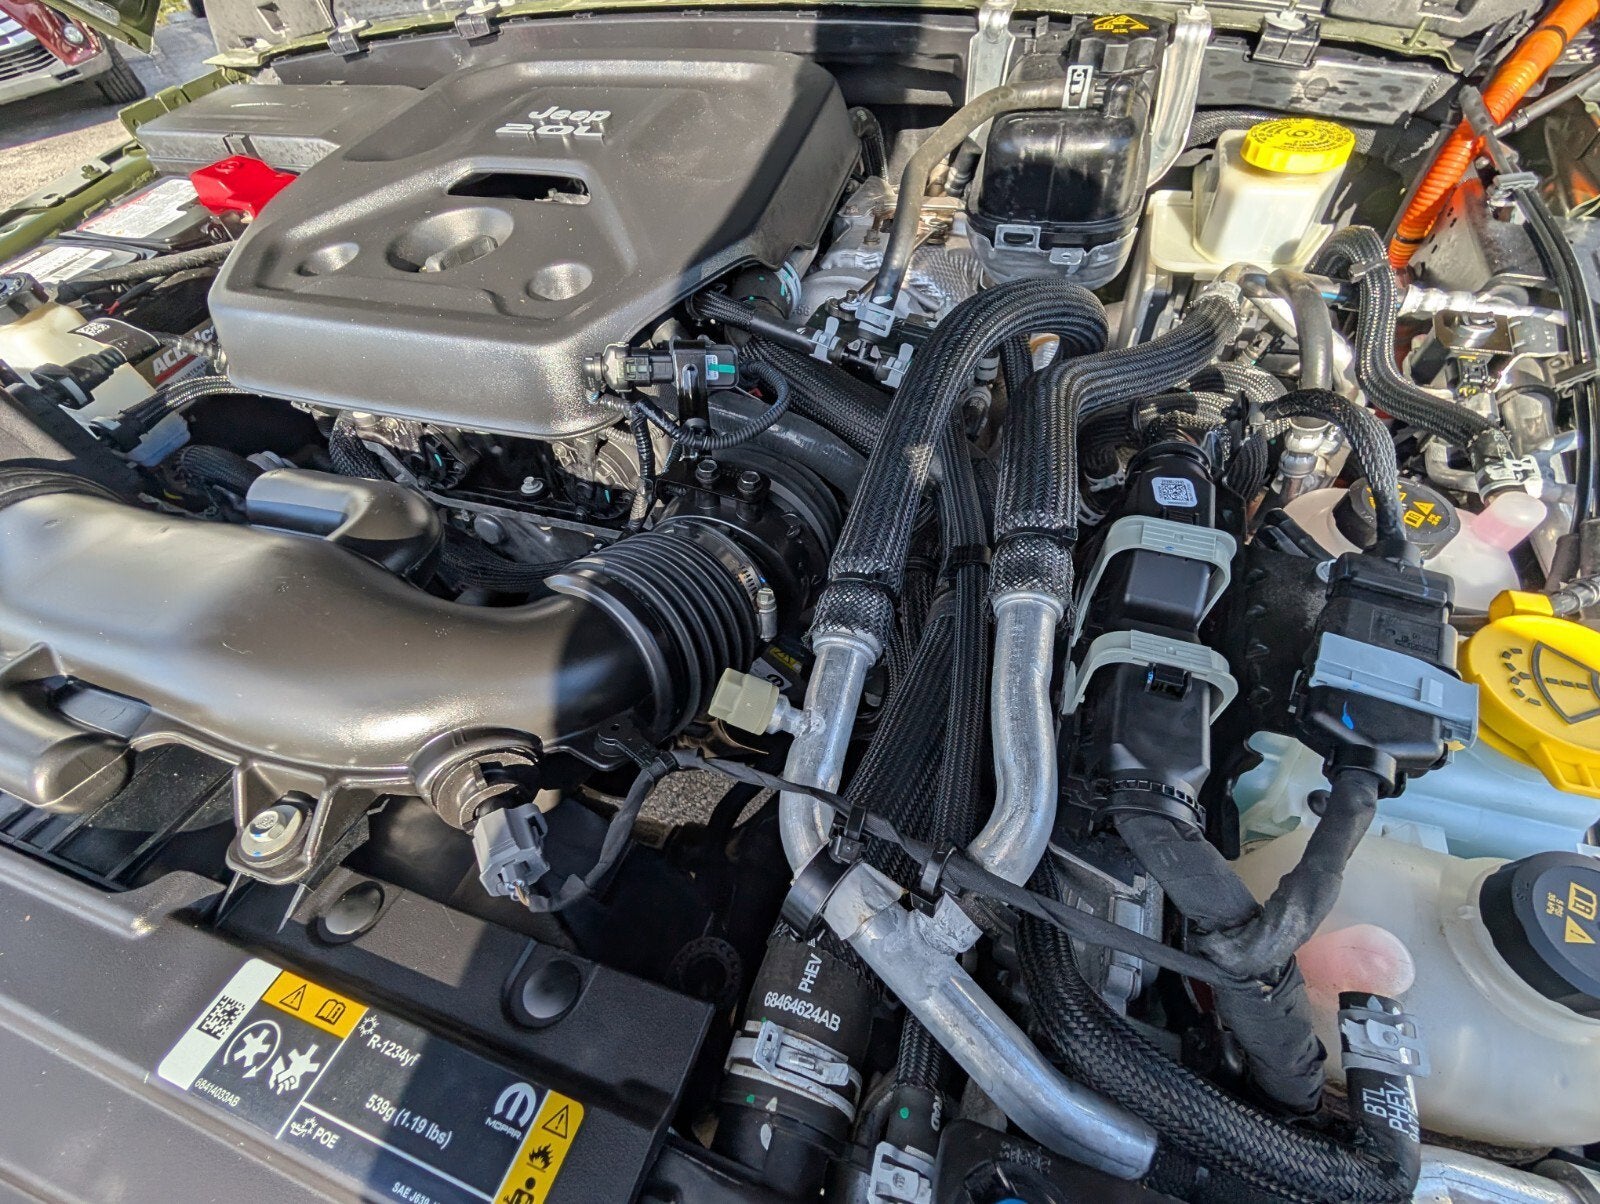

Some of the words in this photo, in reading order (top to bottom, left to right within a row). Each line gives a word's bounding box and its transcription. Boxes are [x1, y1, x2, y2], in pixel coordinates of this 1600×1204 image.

[528, 106, 612, 124] Jeep
[798, 953, 822, 993] PHEV
[764, 991, 841, 1032] 68464624AB
[367, 1034, 421, 1068] R-1234yf
[1362, 1087, 1388, 1118] BTL
[1384, 1079, 1410, 1134] PHEV
[313, 1124, 340, 1150] POE
[365, 1094, 395, 1123] 539g
[393, 1101, 428, 1135] (1.19
[427, 1120, 454, 1151] lbs)
[484, 1116, 522, 1141] MOPAR
[391, 1181, 412, 1199] SAE
